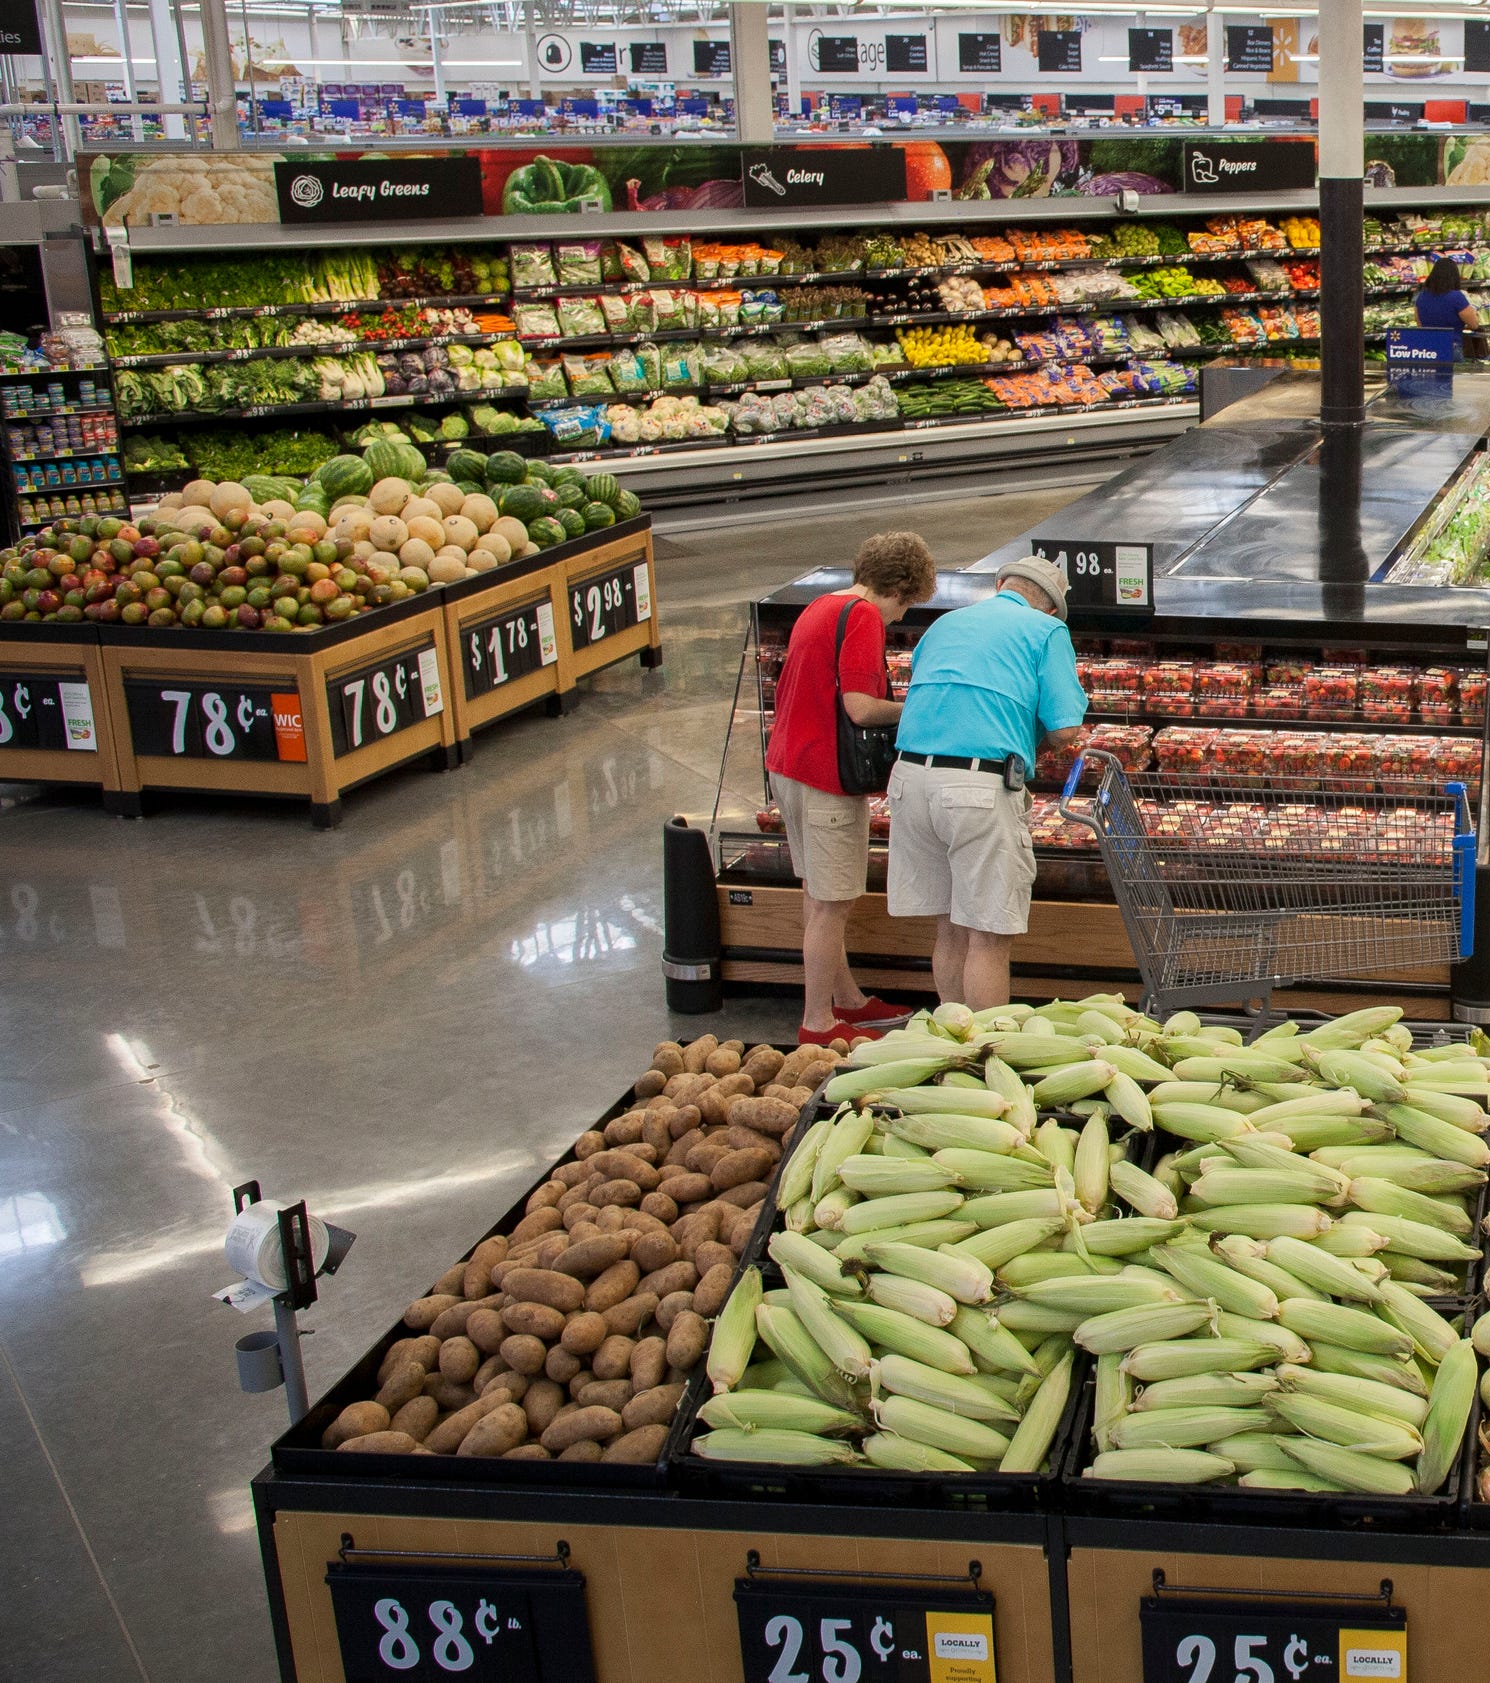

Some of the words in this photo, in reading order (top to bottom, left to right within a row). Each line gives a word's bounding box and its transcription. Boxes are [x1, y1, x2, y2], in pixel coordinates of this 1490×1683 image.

[0, 30, 21, 44] ies
[857, 43, 885, 71] age
[1218, 158, 1257, 174] Peppers
[787, 169, 824, 186] Celery
[332, 182, 376, 201] Leafy
[380, 180, 430, 197] Greens
[1389, 350, 1411, 359] Low
[1411, 349, 1437, 360] Price
[1119, 577, 1144, 586] FRESH
[541, 635, 554, 647] FRESH
[424, 681, 439, 696] FRESH
[344, 663, 407, 747] 78¢
[68, 718, 92, 727] FRESH
[160, 690, 255, 756] 78¢
[273, 714, 303, 728] WIC
[374, 1598, 500, 1671] 88¢
[507, 1617, 522, 1630] lb.
[765, 1615, 896, 1683] 25¢
[902, 1648, 922, 1660] ea.
[941, 1639, 981, 1648] LOCALLY
[1176, 1635, 1309, 1683] 25¢
[1314, 1654, 1333, 1665] ea.
[1353, 1656, 1393, 1665] LOCALLY
[950, 1667, 976, 1676] Proudly
[946, 1675, 982, 1683] supporting
